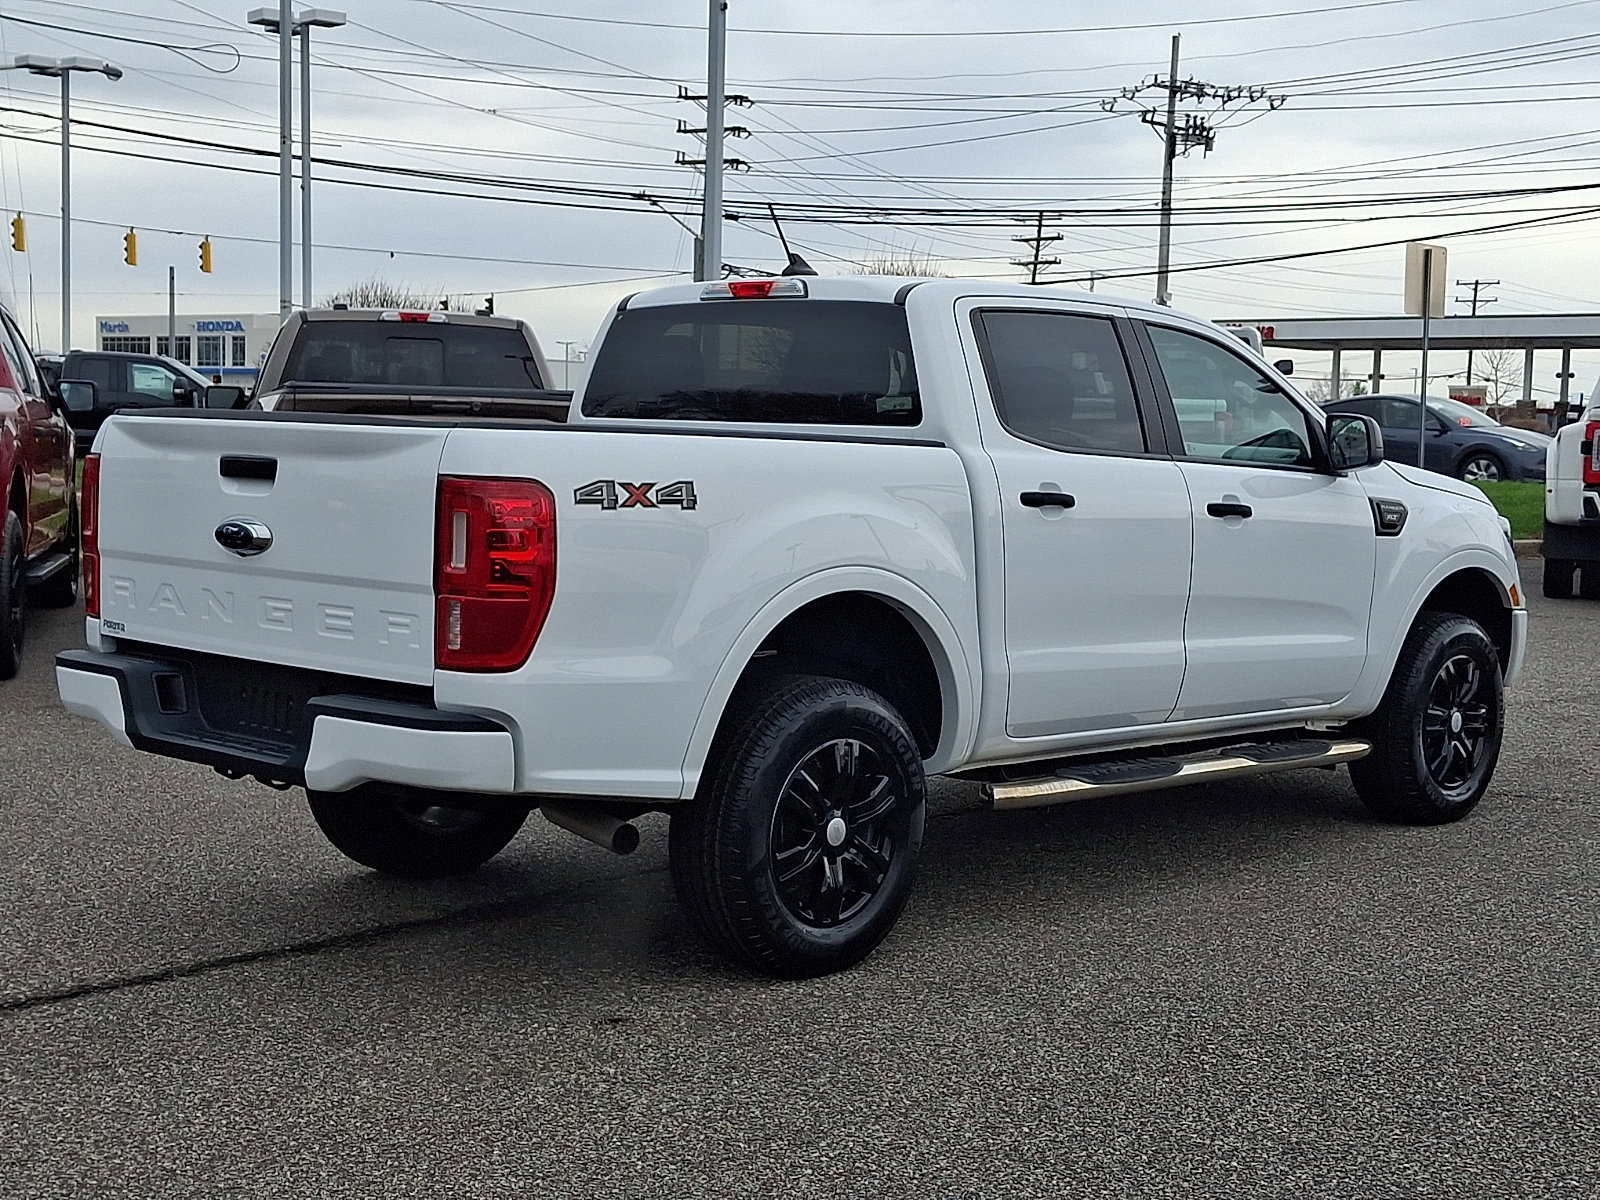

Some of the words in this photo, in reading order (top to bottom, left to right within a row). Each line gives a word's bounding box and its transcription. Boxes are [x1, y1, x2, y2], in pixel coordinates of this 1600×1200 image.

[100, 321, 130, 334] Martin
[196, 320, 245, 332] HONDA
[107, 575, 420, 648] RANGER
